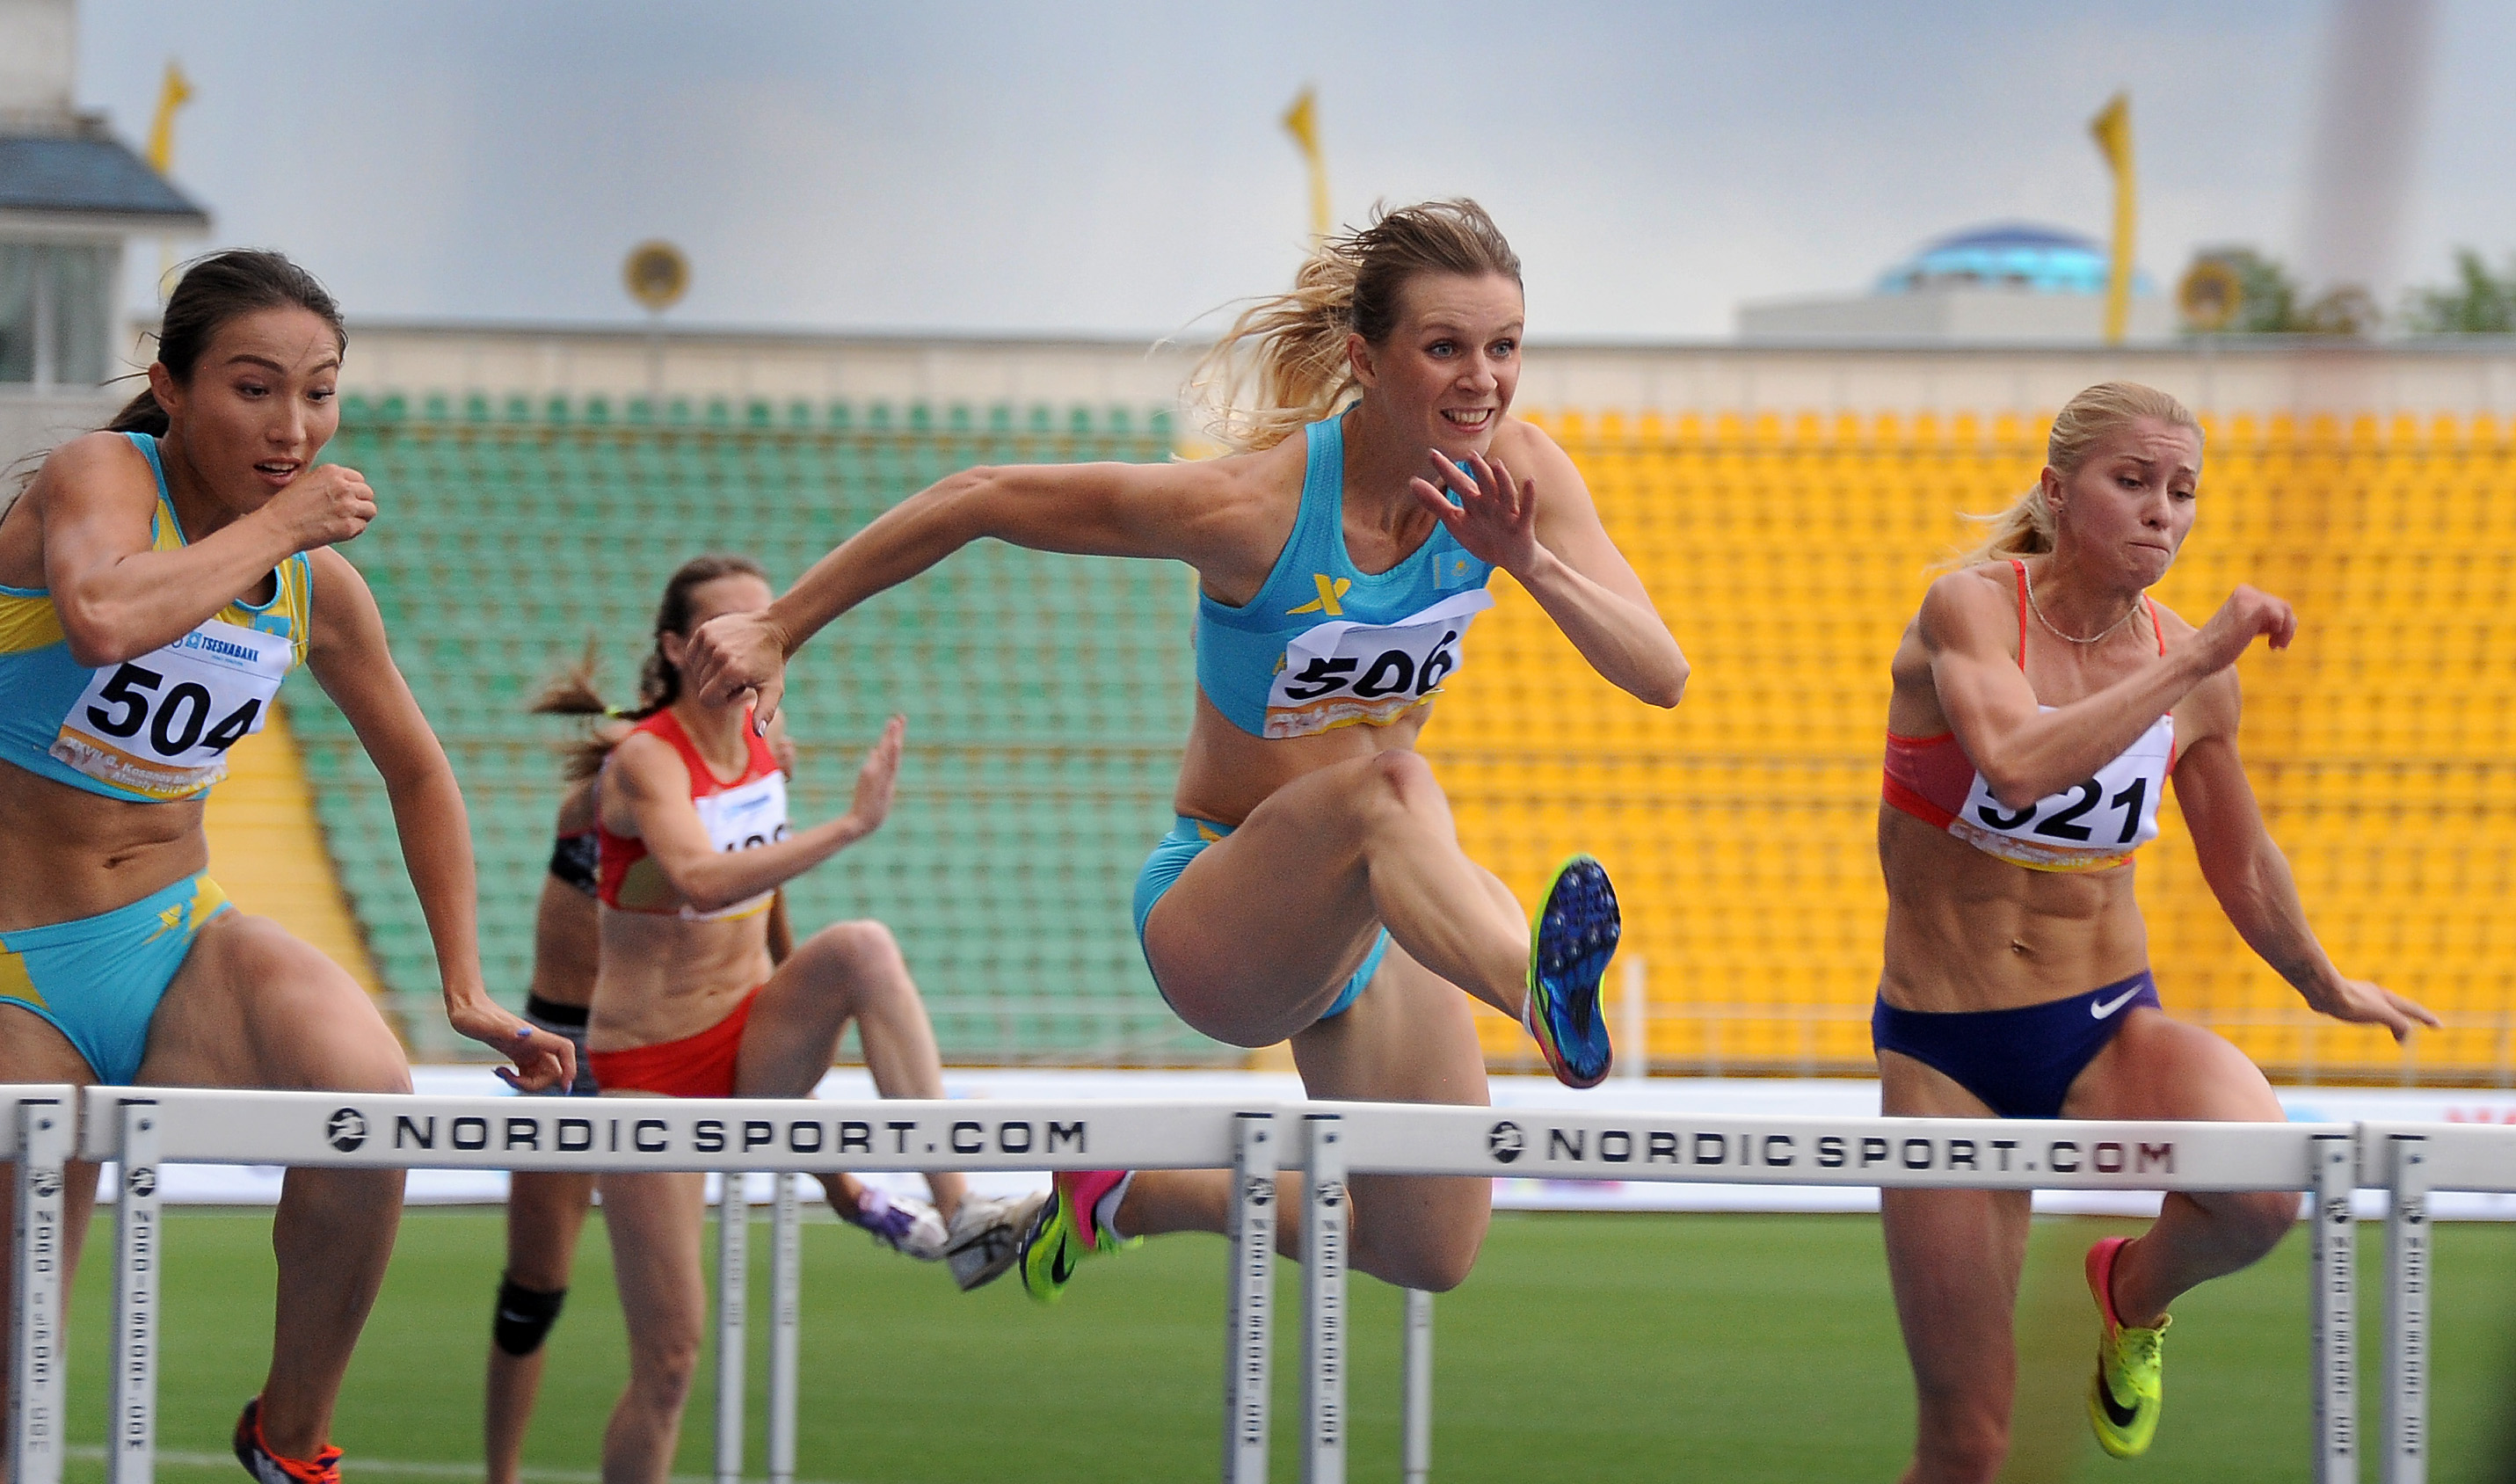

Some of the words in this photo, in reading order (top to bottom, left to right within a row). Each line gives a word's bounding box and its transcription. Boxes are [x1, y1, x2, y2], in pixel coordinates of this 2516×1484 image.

[1283, 629, 1457, 701] 506
[86, 663, 262, 757] 504
[394, 1115, 669, 1153] NORDIC
[694, 1120, 1087, 1154] SPORT.COM
[1547, 1128, 1797, 1168] NORDIC
[1816, 1136, 2175, 1175] SPORT.COM
